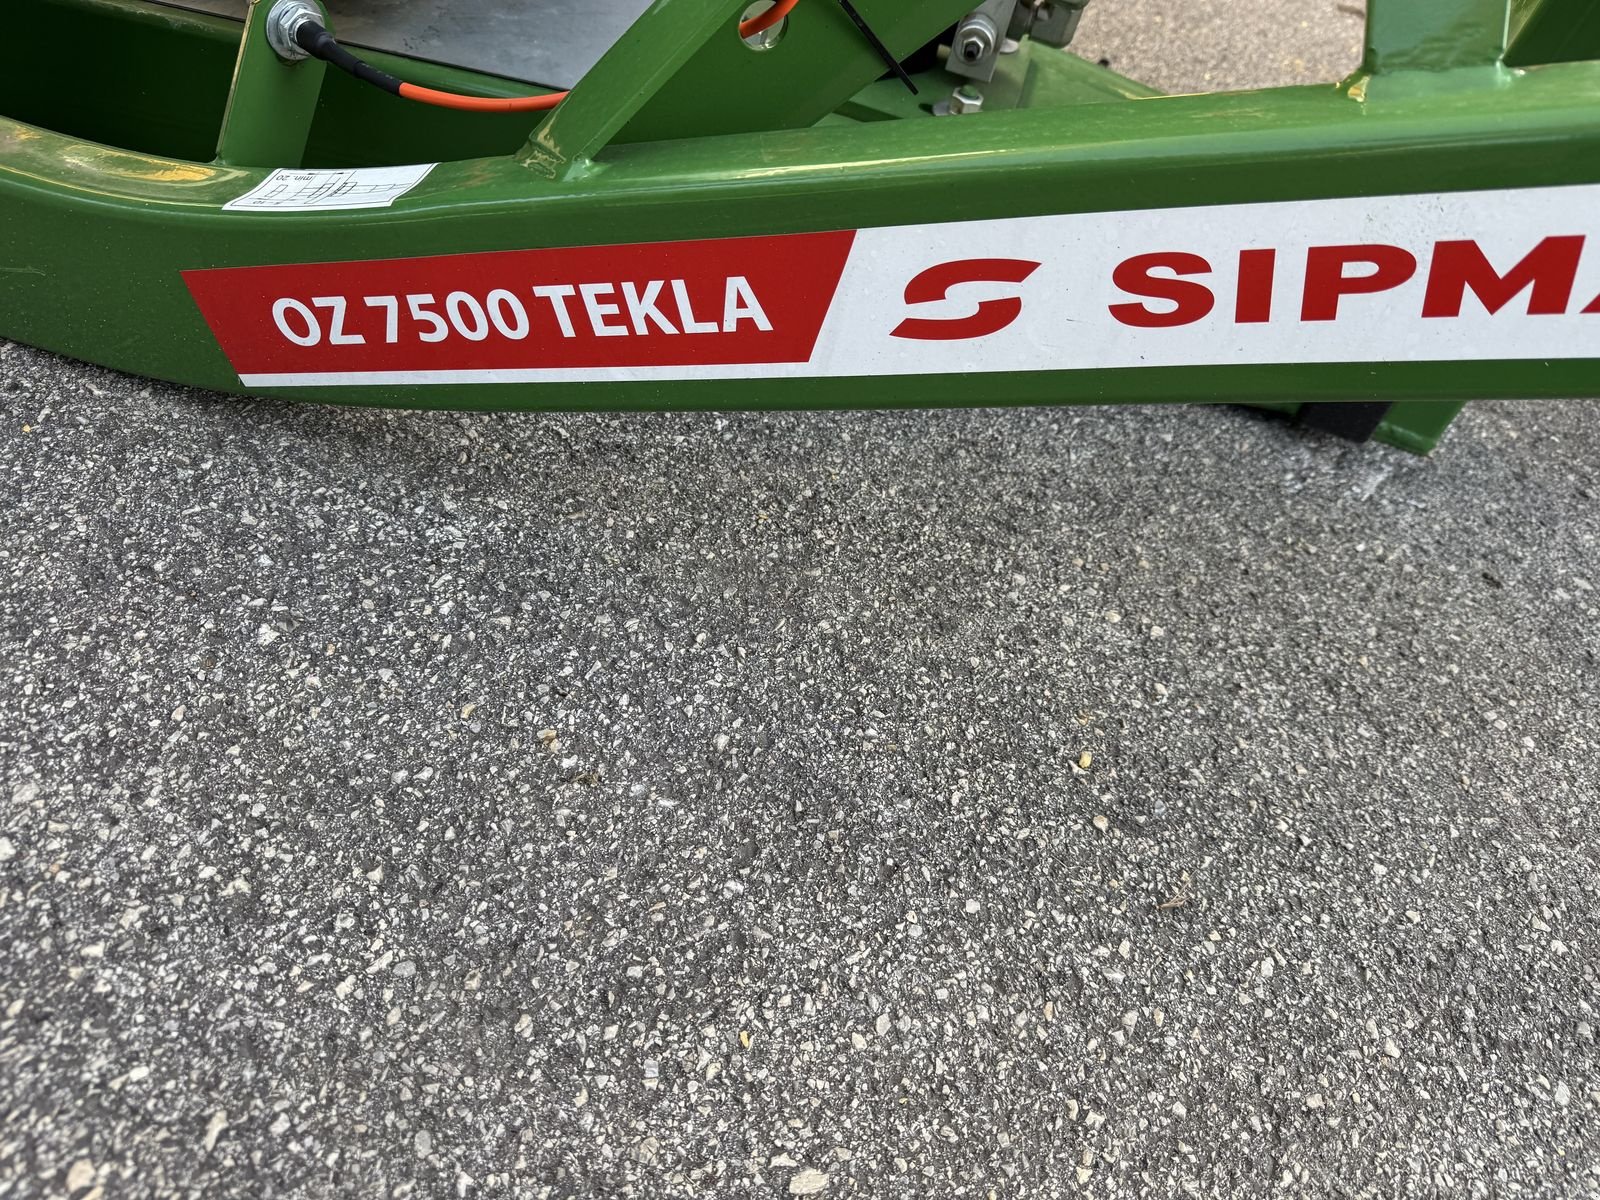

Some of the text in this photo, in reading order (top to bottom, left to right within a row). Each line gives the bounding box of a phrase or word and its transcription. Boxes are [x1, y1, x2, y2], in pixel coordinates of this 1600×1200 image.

[272, 275, 774, 347] OZ 7500 TEKLA
